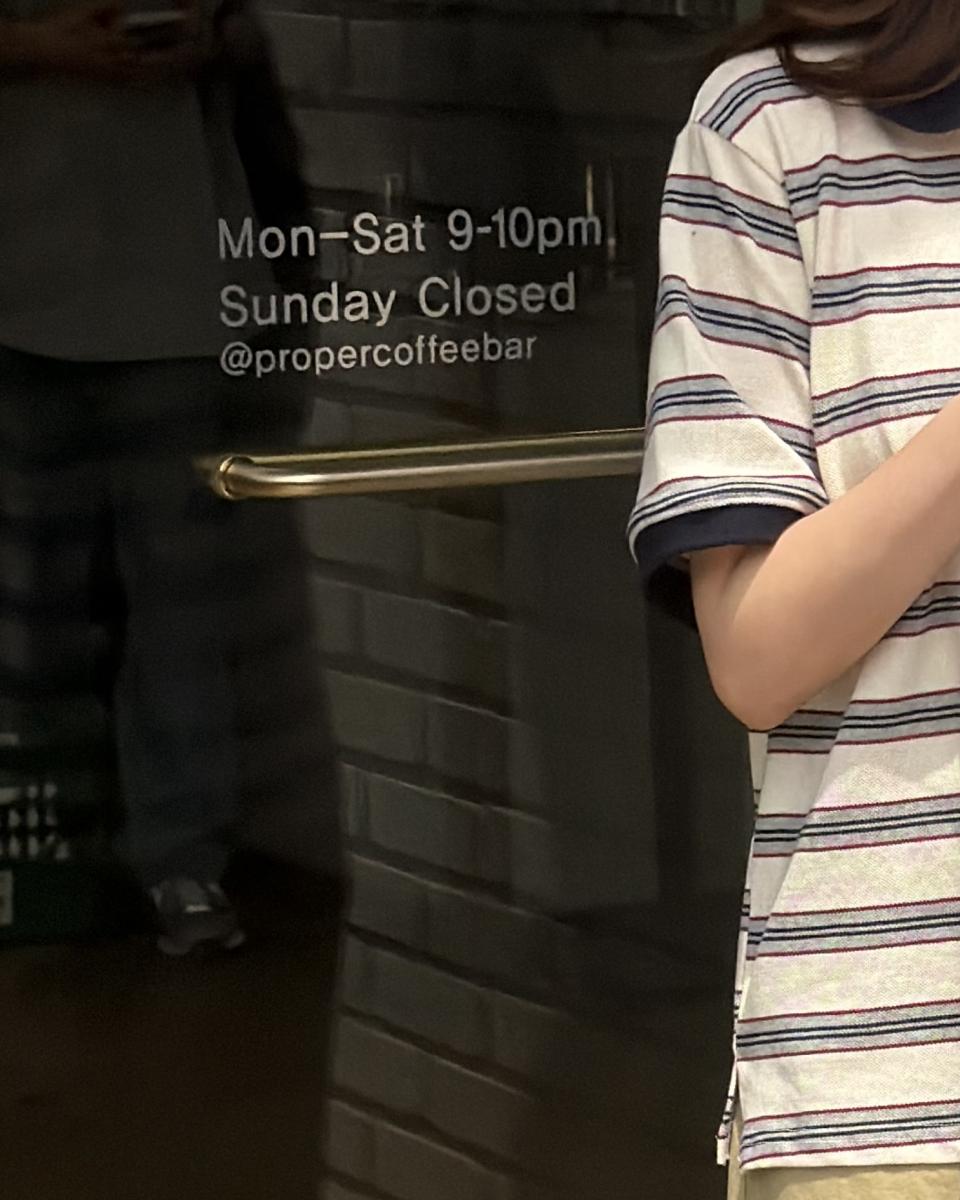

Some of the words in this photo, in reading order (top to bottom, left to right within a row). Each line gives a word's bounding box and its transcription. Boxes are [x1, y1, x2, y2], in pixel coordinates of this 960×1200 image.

[447, 206, 602, 255] 9-10pm
[219, 281, 396, 328] Sunday
[418, 271, 577, 318] Closed
[220, 332, 538, 378] @propercoffeebar
